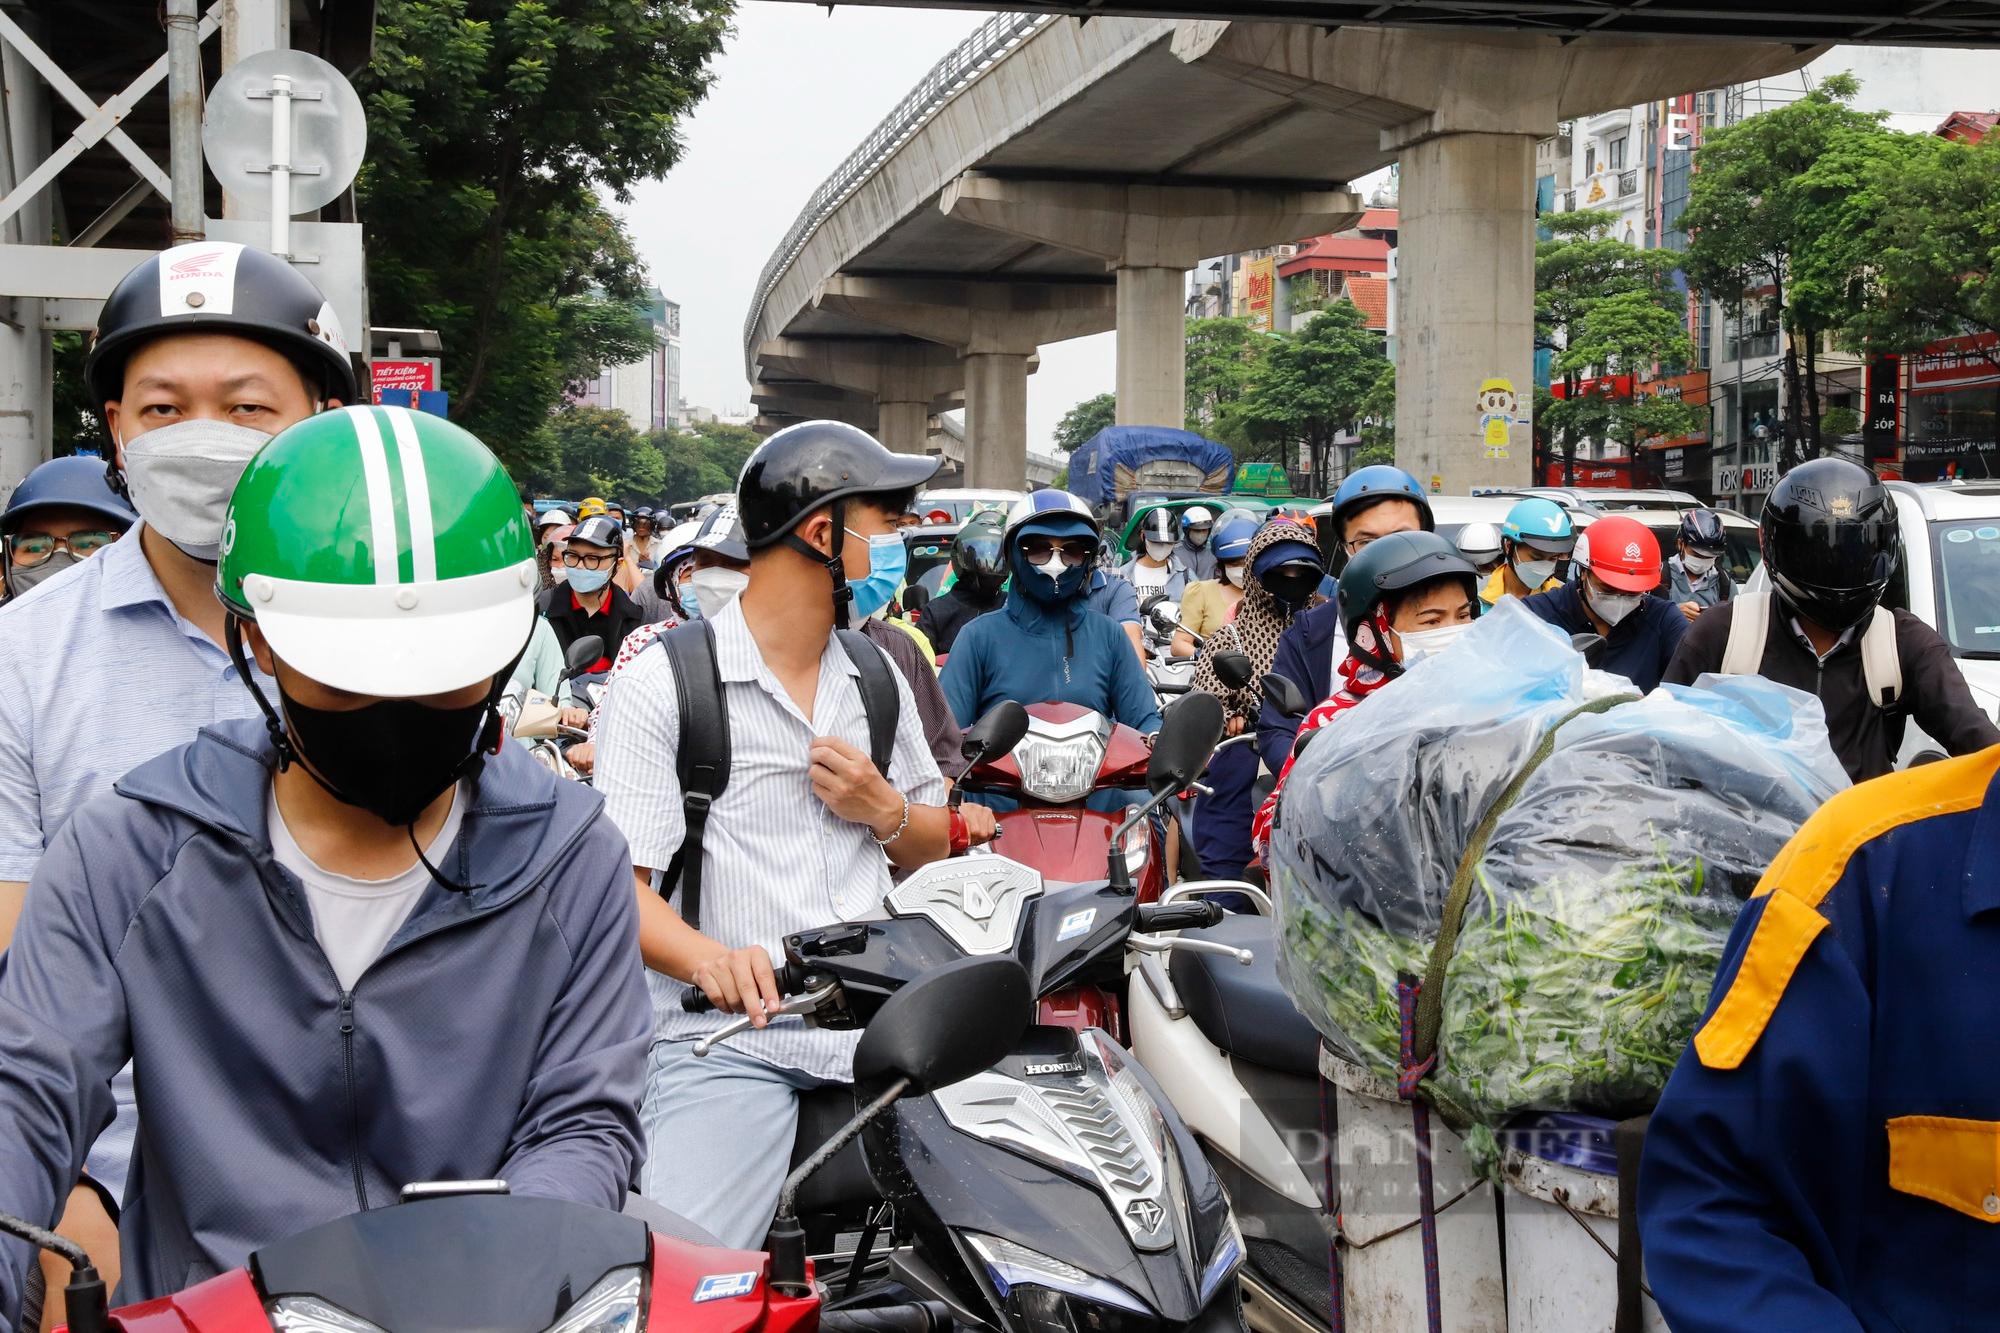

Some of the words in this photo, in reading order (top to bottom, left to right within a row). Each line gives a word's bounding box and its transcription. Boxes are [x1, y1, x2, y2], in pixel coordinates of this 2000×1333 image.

[169, 271, 224, 281] HONDA
[1832, 508, 1851, 516] Royal
[1067, 911, 1091, 926] FI
[1025, 1063, 1084, 1075] HONDA
[702, 1275, 750, 1292] FI
